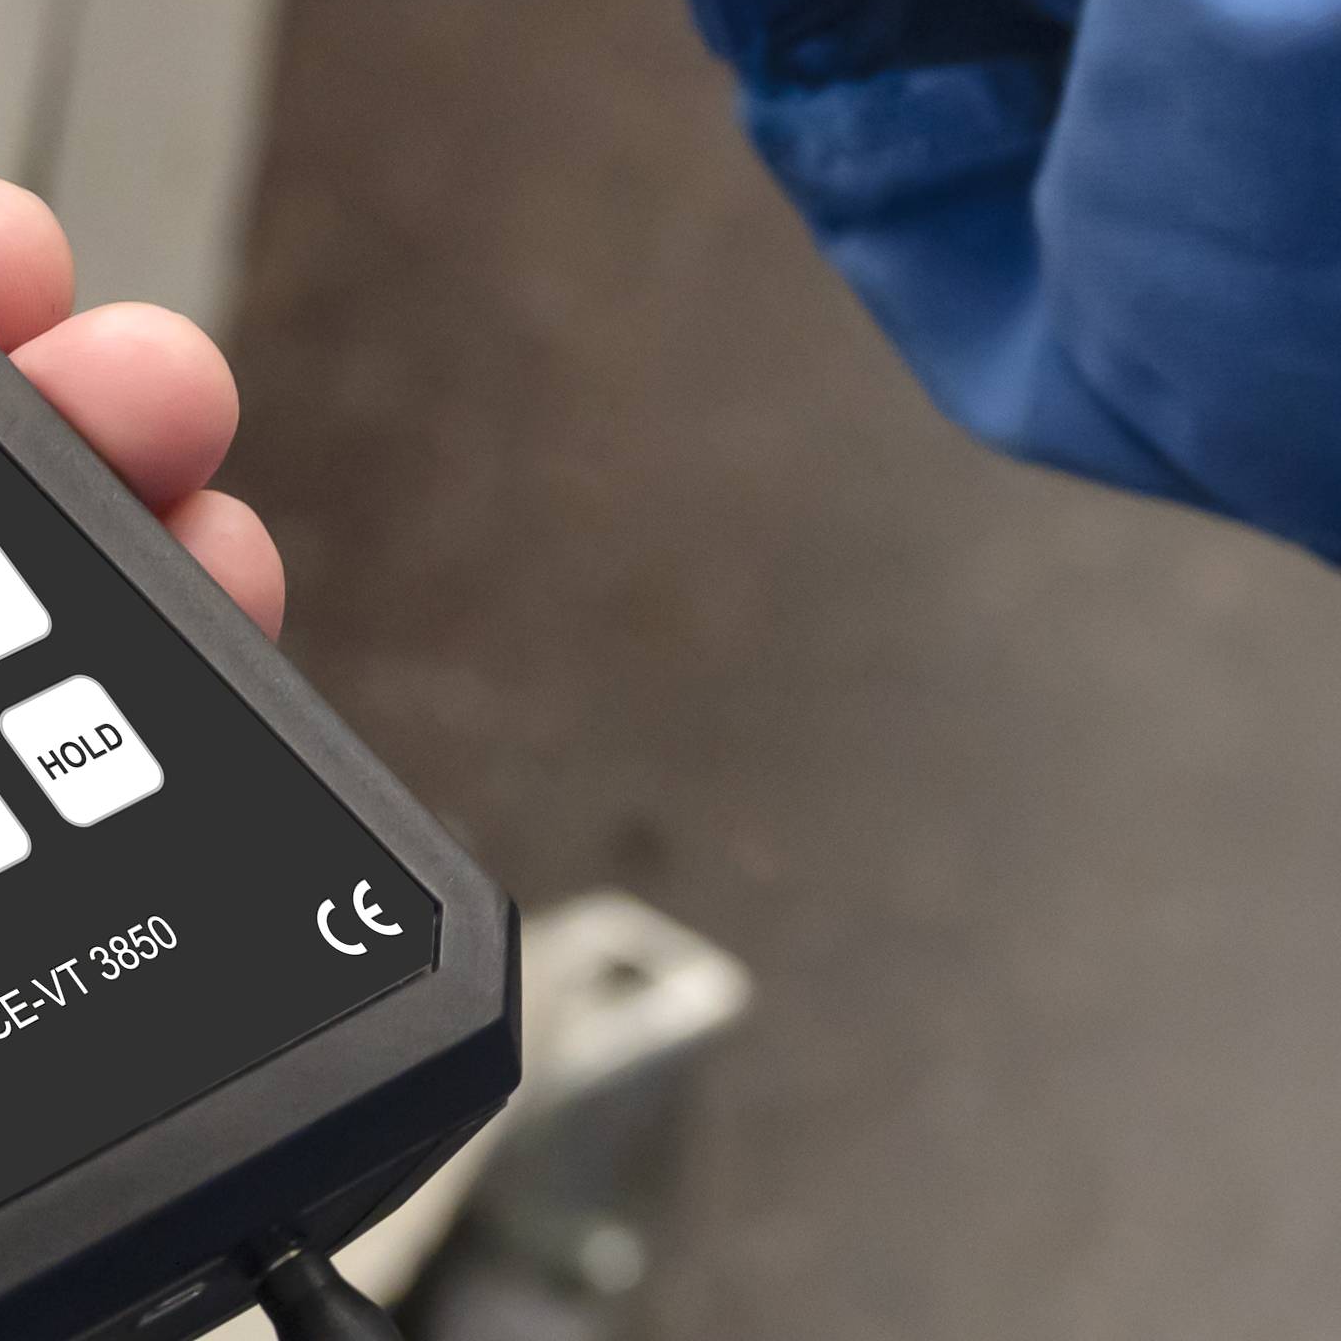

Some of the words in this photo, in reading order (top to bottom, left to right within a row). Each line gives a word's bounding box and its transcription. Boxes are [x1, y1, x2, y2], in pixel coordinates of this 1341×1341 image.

[36, 722, 124, 781] HOLD
[89, 915, 178, 981] 3850
[316, 879, 404, 956] CE
